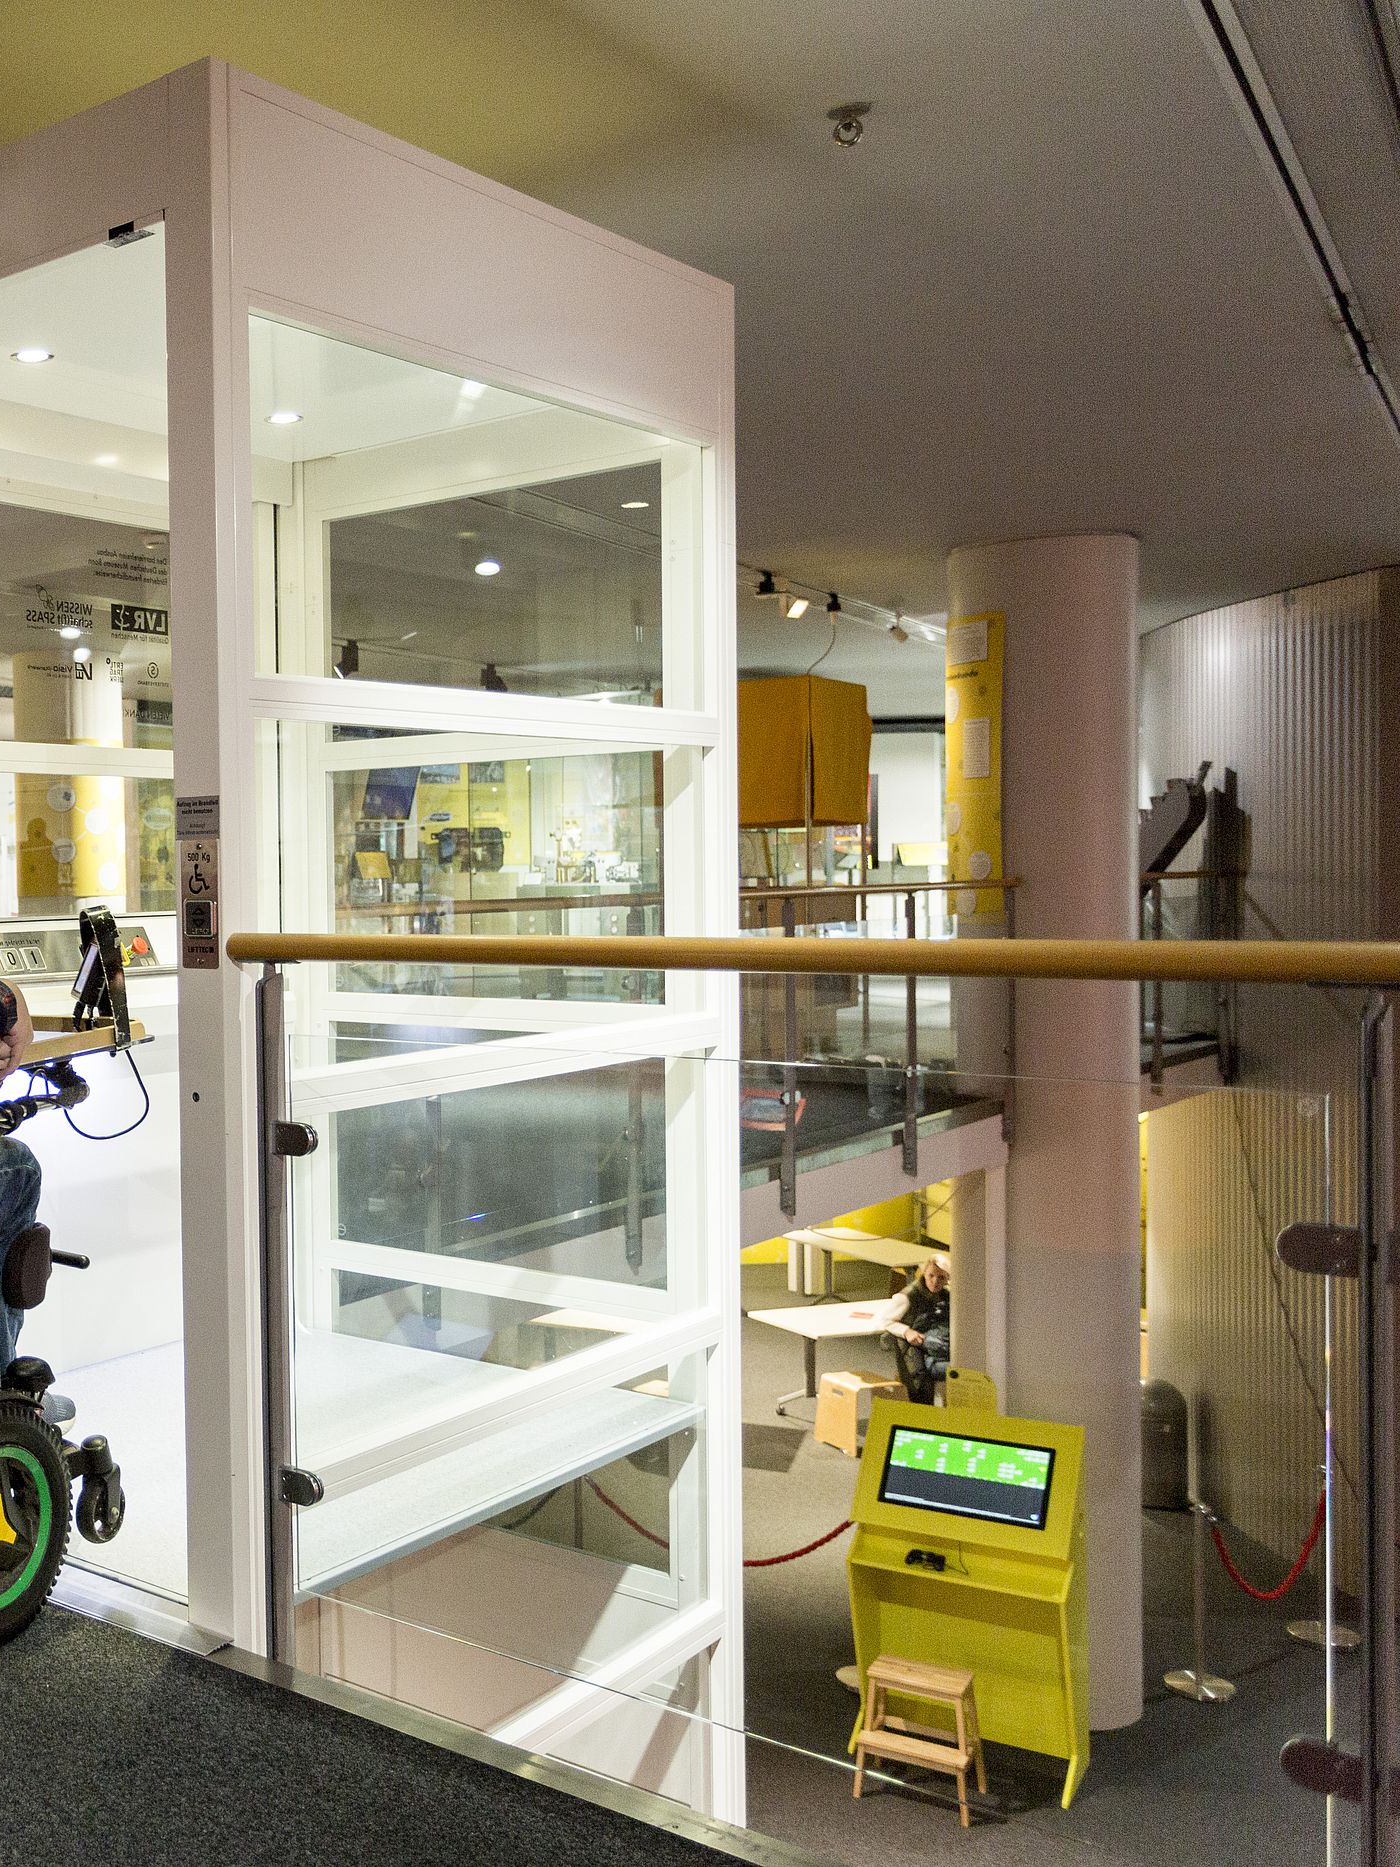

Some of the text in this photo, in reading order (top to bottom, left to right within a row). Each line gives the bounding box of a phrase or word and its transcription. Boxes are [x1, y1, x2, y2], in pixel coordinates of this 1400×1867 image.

[187, 852, 211, 863] 500 Kg
[6, 951, 17, 965] 0
[30, 950, 38, 965] 1
